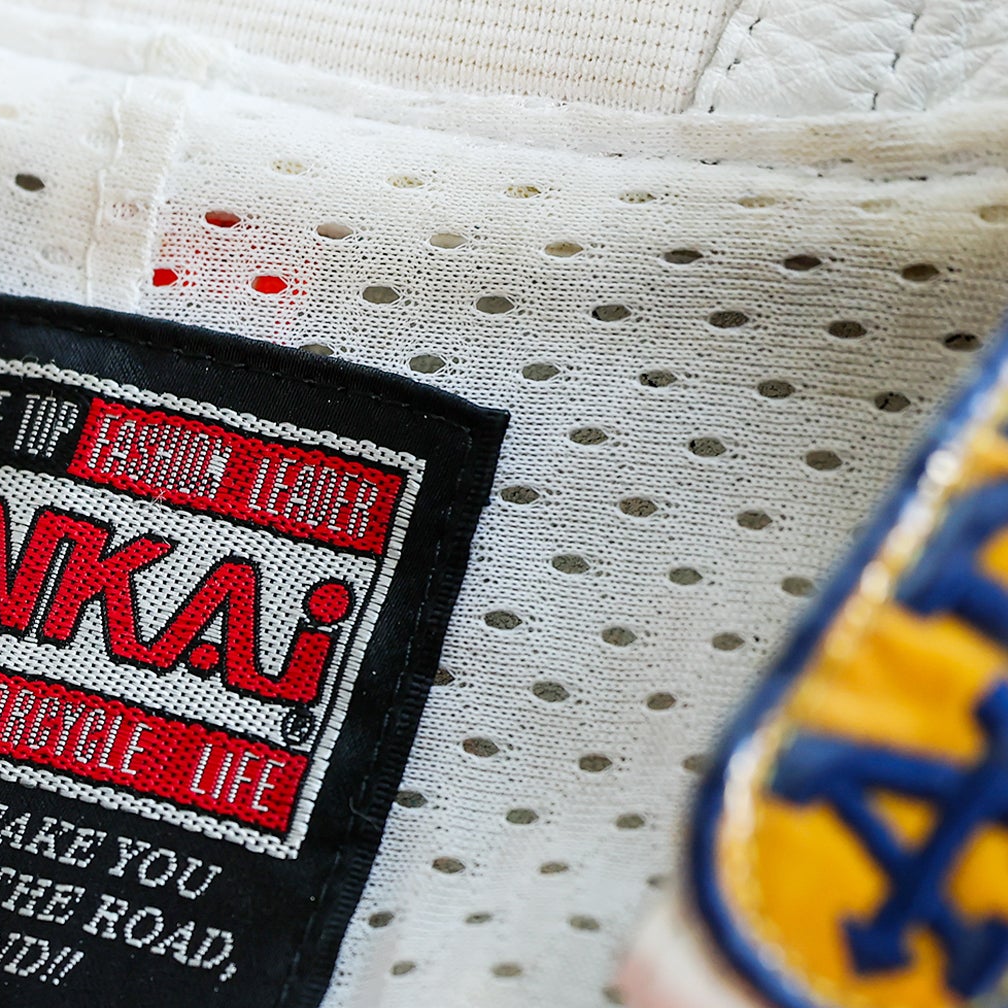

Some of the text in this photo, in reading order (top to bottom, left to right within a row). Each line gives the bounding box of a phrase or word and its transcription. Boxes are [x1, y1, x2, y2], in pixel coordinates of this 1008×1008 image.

[13, 392, 79, 458] TOP
[87, 413, 233, 500] FASHION
[248, 458, 379, 538] LEADER
[191, 743, 286, 813] LIFE
[108, 836, 223, 900] YOU
[82, 893, 238, 982] ROAD,
